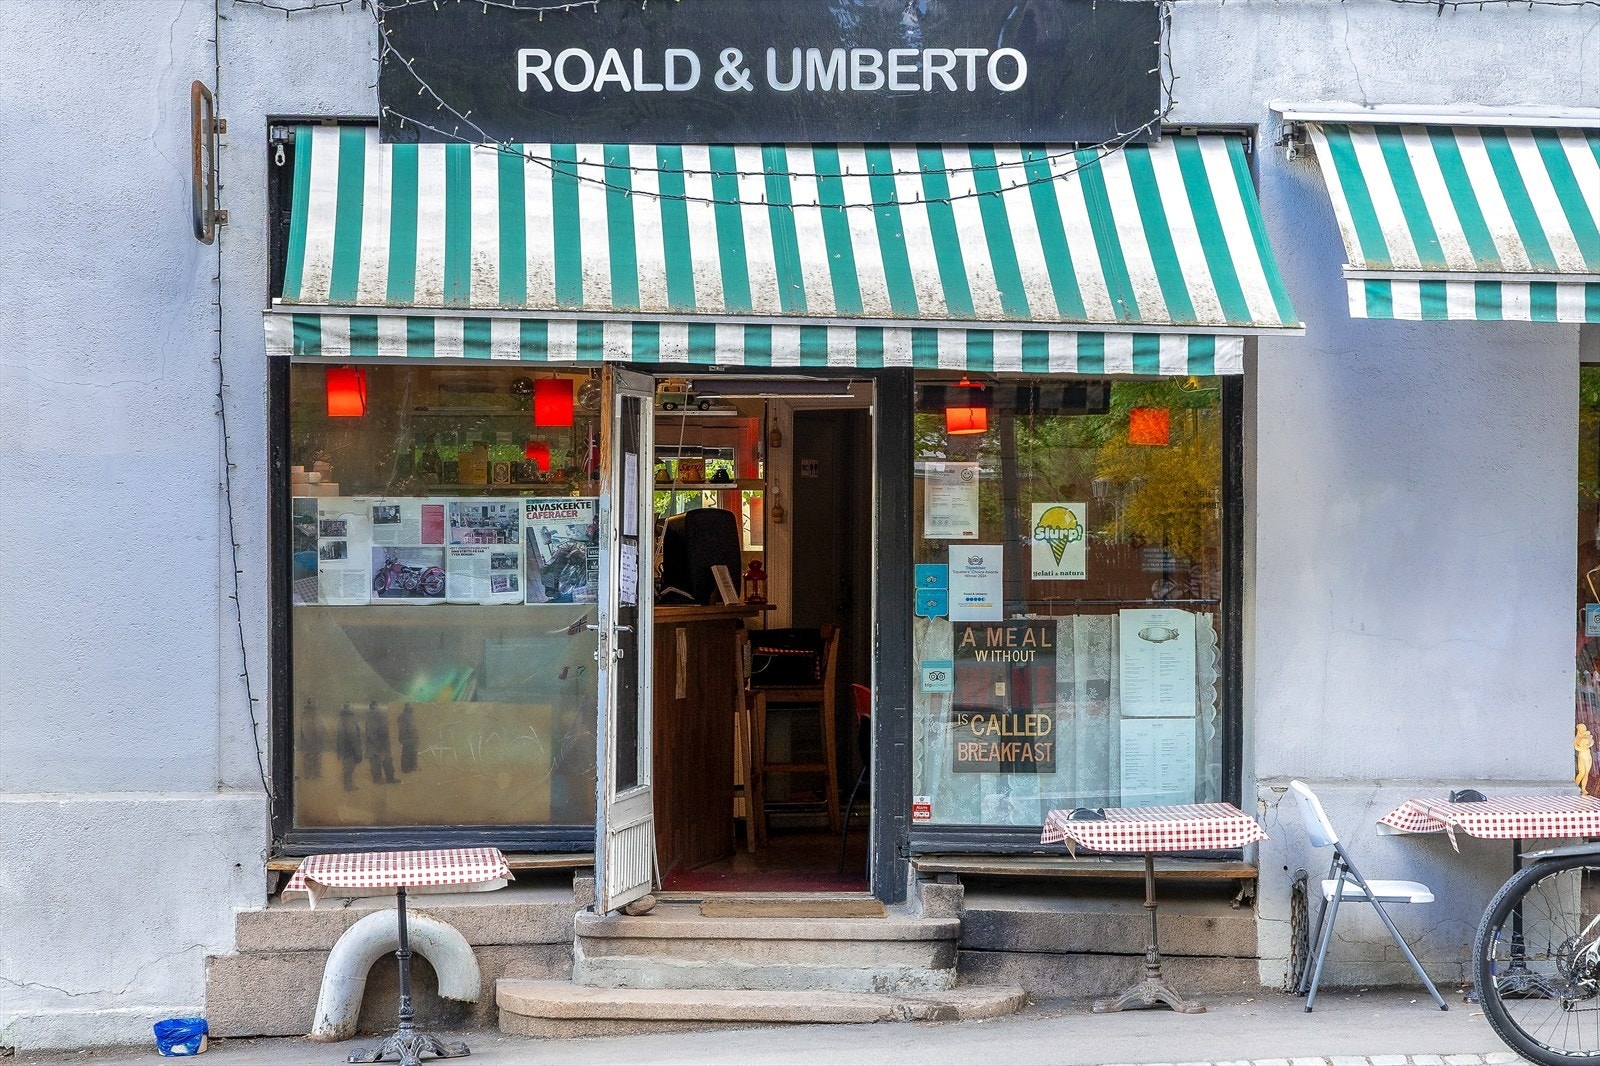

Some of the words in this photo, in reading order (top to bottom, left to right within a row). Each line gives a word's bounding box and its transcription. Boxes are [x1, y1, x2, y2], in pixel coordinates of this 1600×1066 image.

[517, 47, 701, 93] ROALD
[713, 47, 754, 93] &
[766, 47, 1029, 93] UMBERTO
[526, 504, 538, 512] EN
[538, 501, 592, 512] VASKEEKTE
[1034, 524, 1083, 542] Slurp!
[961, 626, 977, 647] A
[986, 627, 1052, 647] MEAL
[974, 649, 1036, 662] WITHOUT
[957, 713, 969, 726] IS
[970, 713, 1052, 737] CALLED
[957, 742, 1053, 762] BREAKFAST
